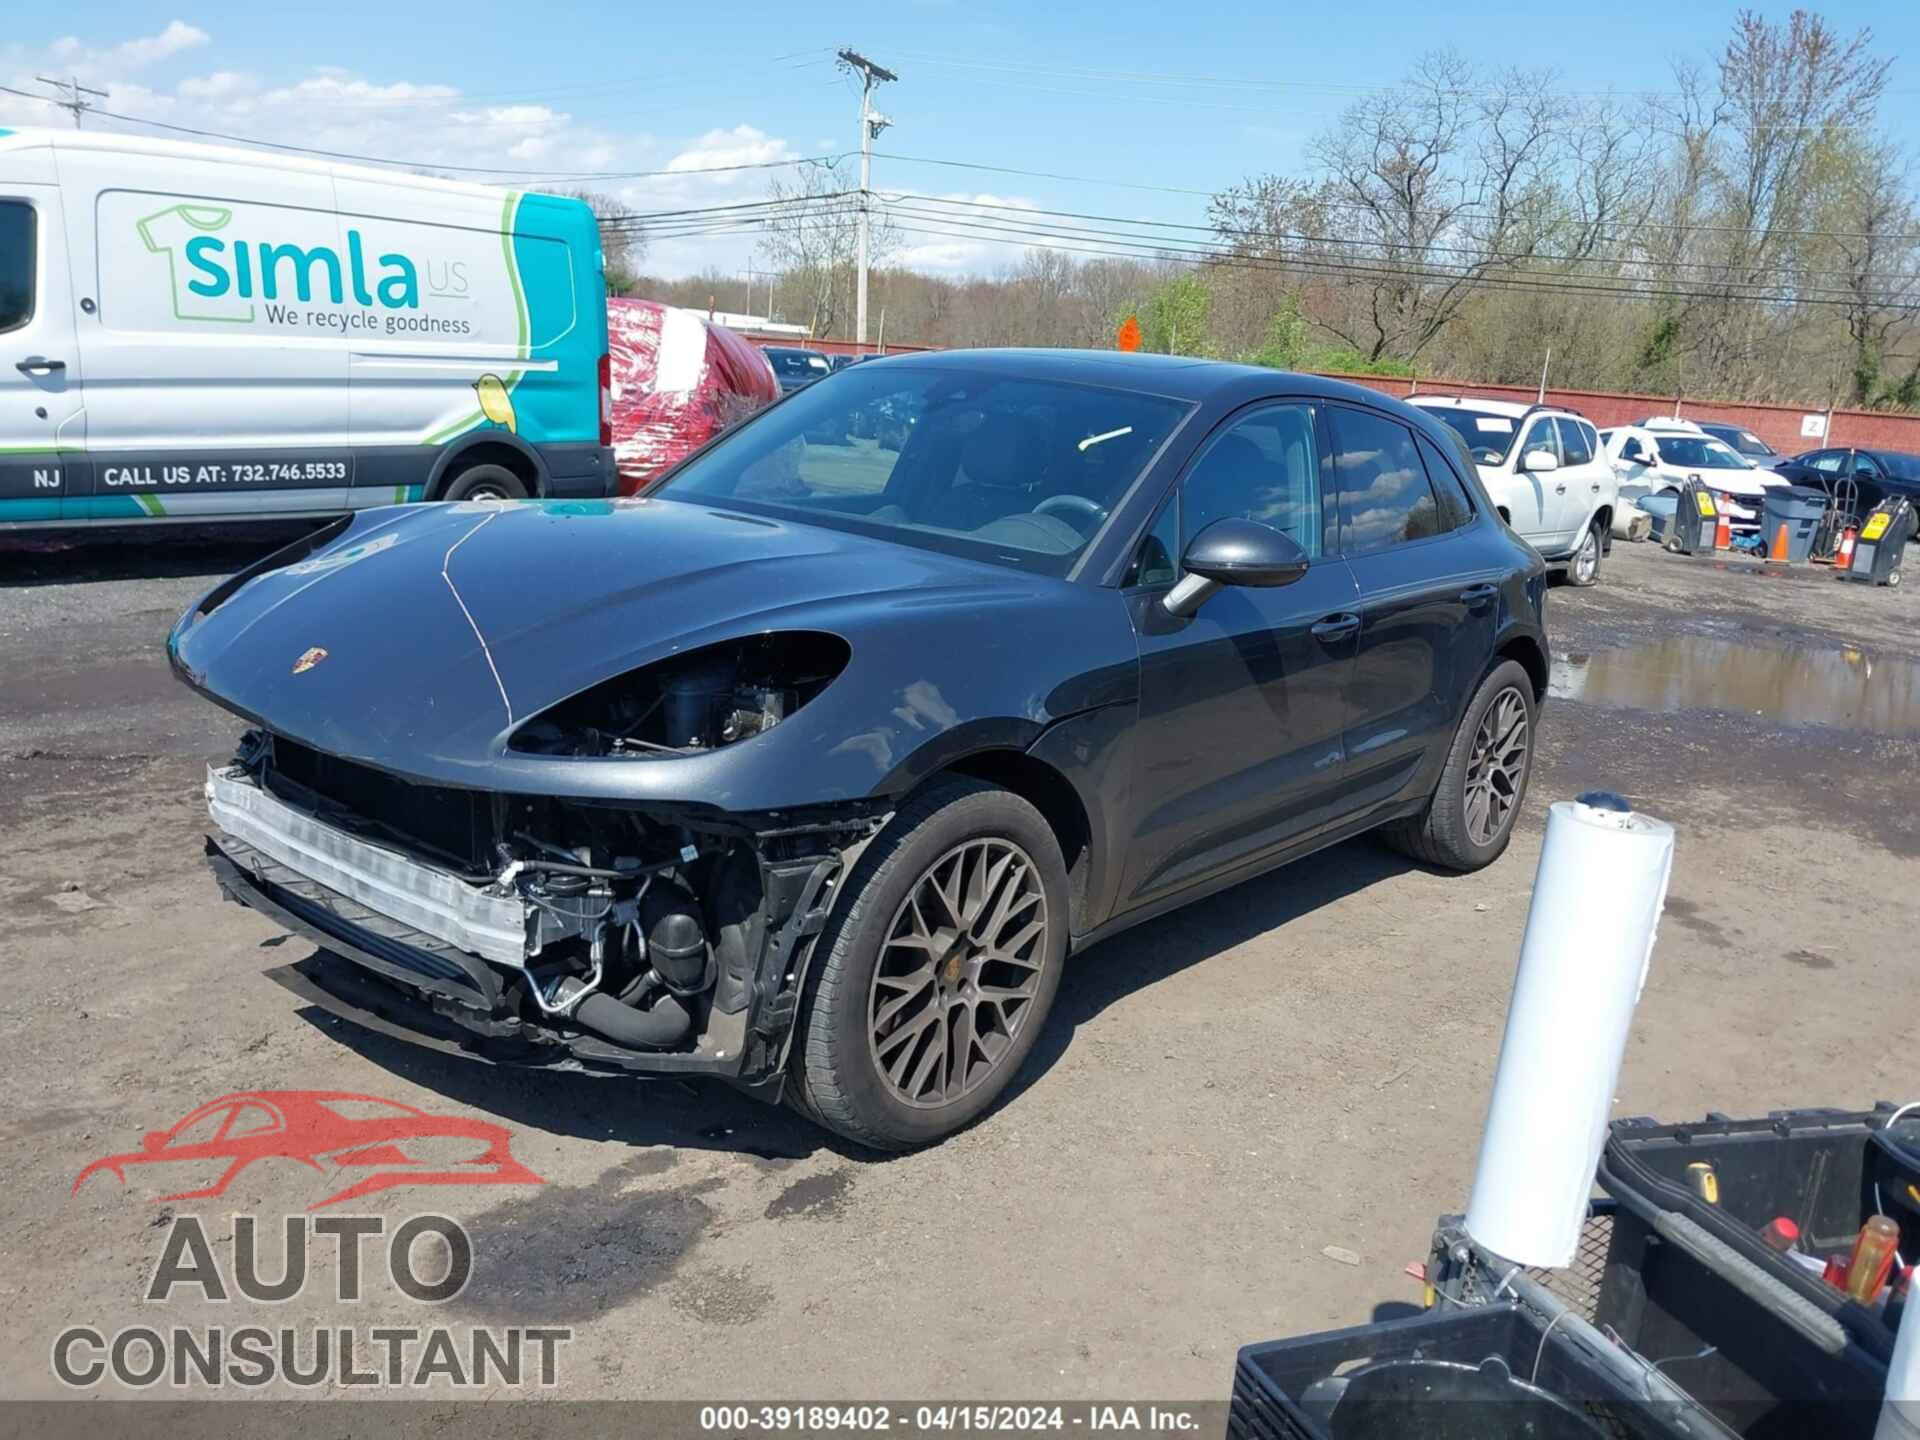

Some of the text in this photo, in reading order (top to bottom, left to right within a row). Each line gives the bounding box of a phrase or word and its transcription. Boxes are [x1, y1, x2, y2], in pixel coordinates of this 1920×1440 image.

[426, 258, 470, 294] US
[265, 303, 471, 335] We recycle goodness
[33, 469, 61, 488] NJ
[104, 462, 347, 486] CALL US AT: 732.746.5533
